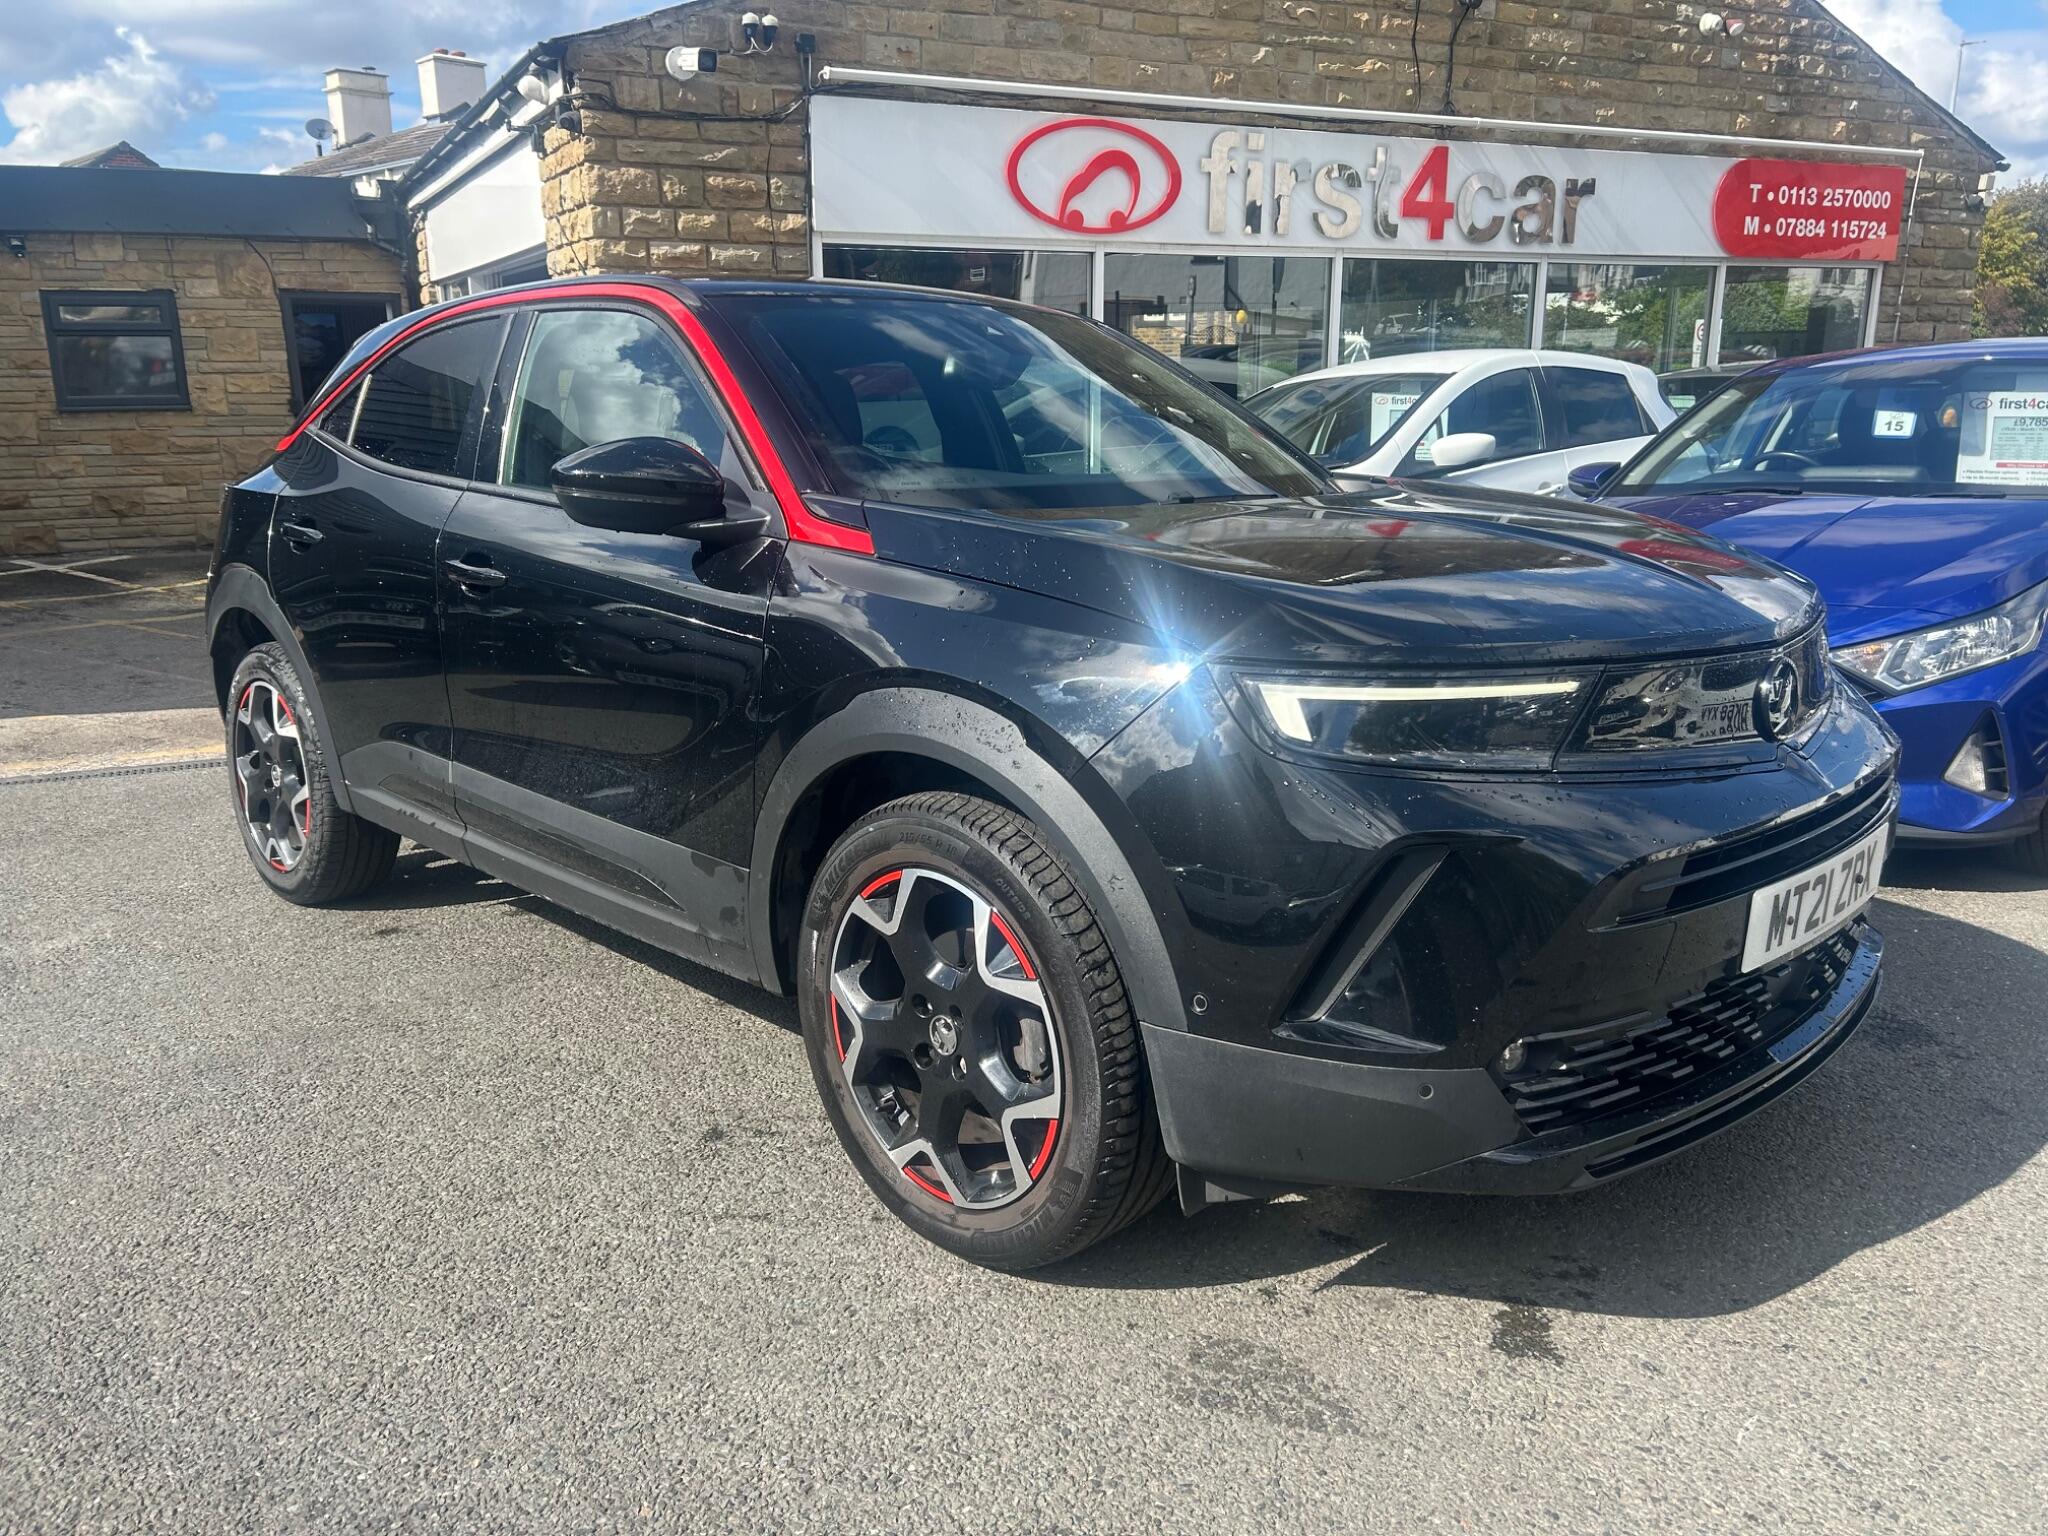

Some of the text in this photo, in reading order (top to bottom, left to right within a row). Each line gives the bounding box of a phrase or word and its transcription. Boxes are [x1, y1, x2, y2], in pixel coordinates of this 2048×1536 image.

[1200, 131, 1597, 245] first4car
[1750, 184, 1891, 209] T 0113 2570000
[1743, 216, 1887, 240] M 07884 115724
[1884, 420, 1905, 432] 15
[1764, 840, 1878, 953] MT21 ZRX
